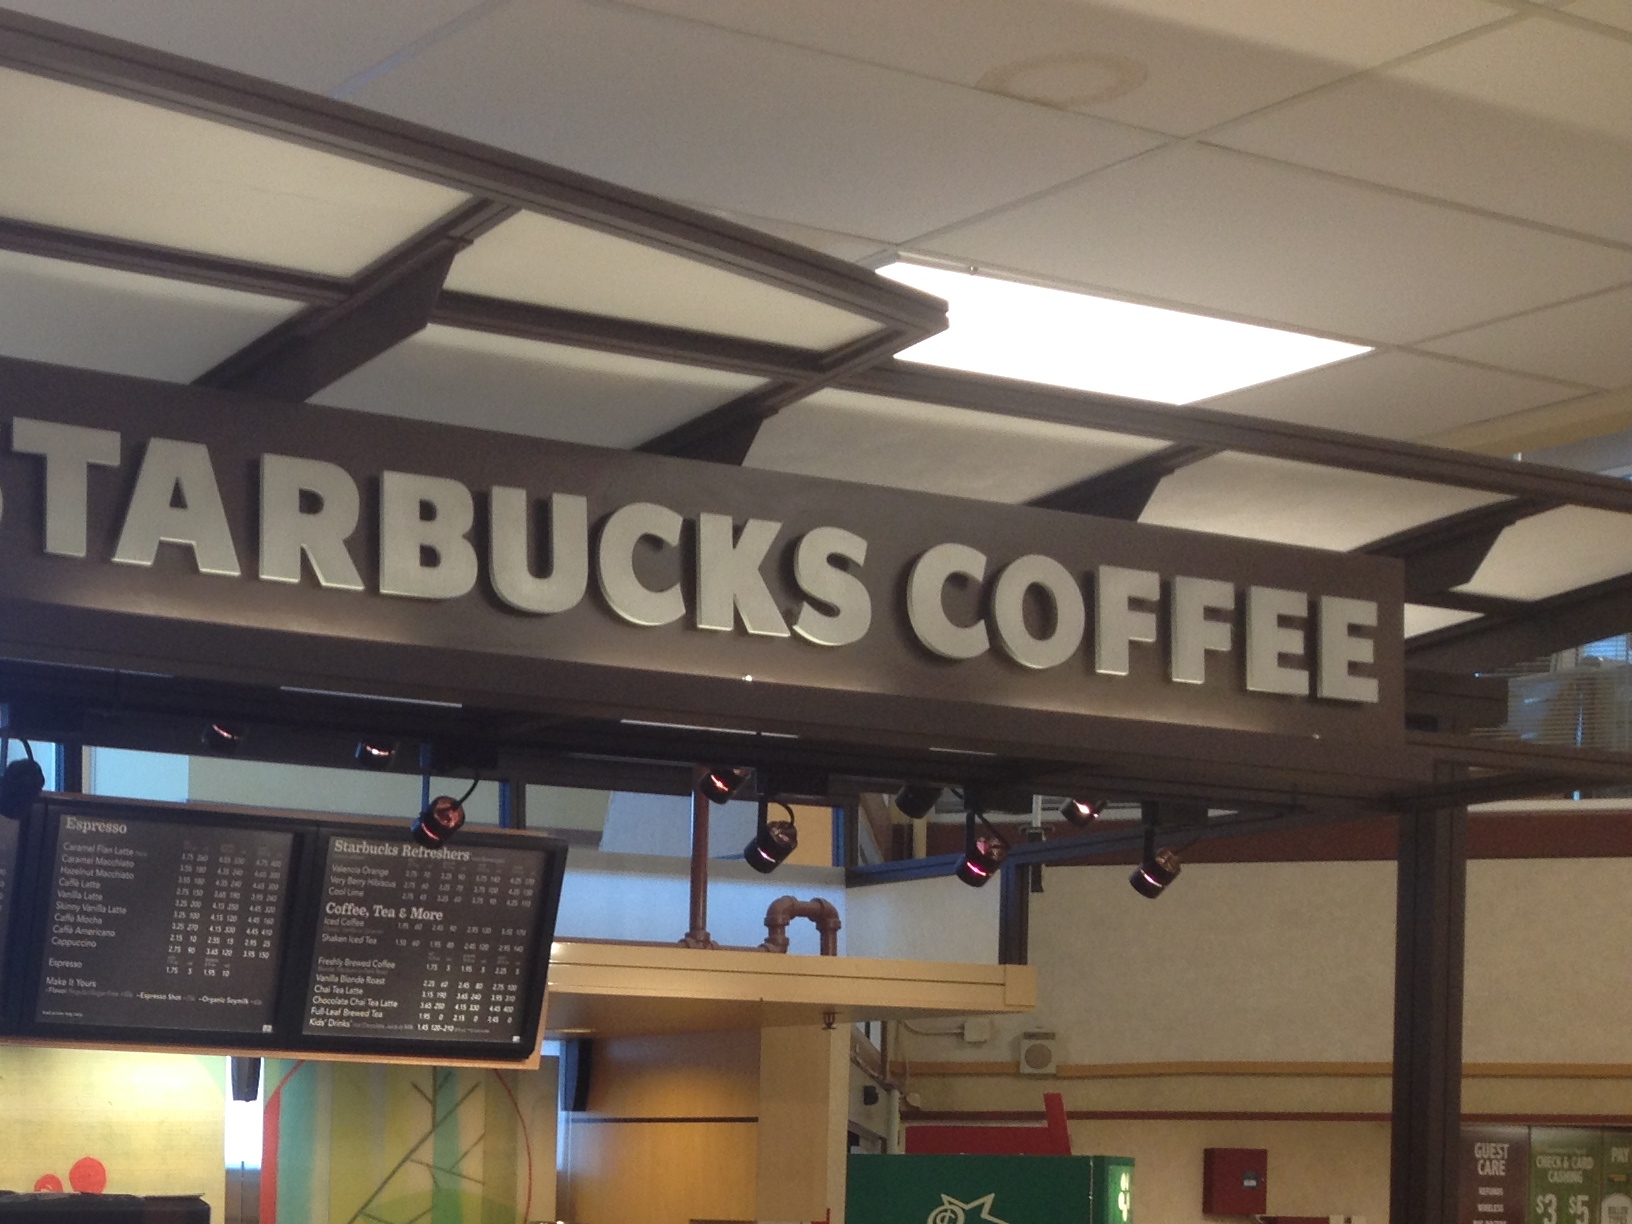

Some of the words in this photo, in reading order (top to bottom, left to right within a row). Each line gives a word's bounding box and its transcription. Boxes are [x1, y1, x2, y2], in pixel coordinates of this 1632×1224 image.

[907, 542, 1379, 703] COFFEE
[66, 817, 128, 834] Espresso
[334, 840, 399, 856] Starbucks
[401, 844, 471, 861] Refreshers
[56, 900, 81, 912] Skinny
[82, 902, 107, 913] Vanilla
[107, 905, 127, 915] Latte
[325, 901, 370, 919] Coffee,
[373, 904, 396, 918] Tea
[398, 907, 407, 918] &
[410, 906, 444, 920] More
[51, 936, 97, 948] Cappuccino
[48, 957, 82, 969] Espresso
[318, 956, 343, 968] Freshly
[344, 958, 371, 967] Brewed
[372, 959, 396, 969] Coffee
[312, 995, 349, 1005] Chocolate
[349, 997, 366, 1006] Chai
[367, 998, 379, 1007] Tea
[380, 999, 399, 1008] Latte
[1474, 1142, 1510, 1159] GUEST
[1477, 1159, 1506, 1176] CARE
[1535, 1155, 1562, 1168] CHECK
